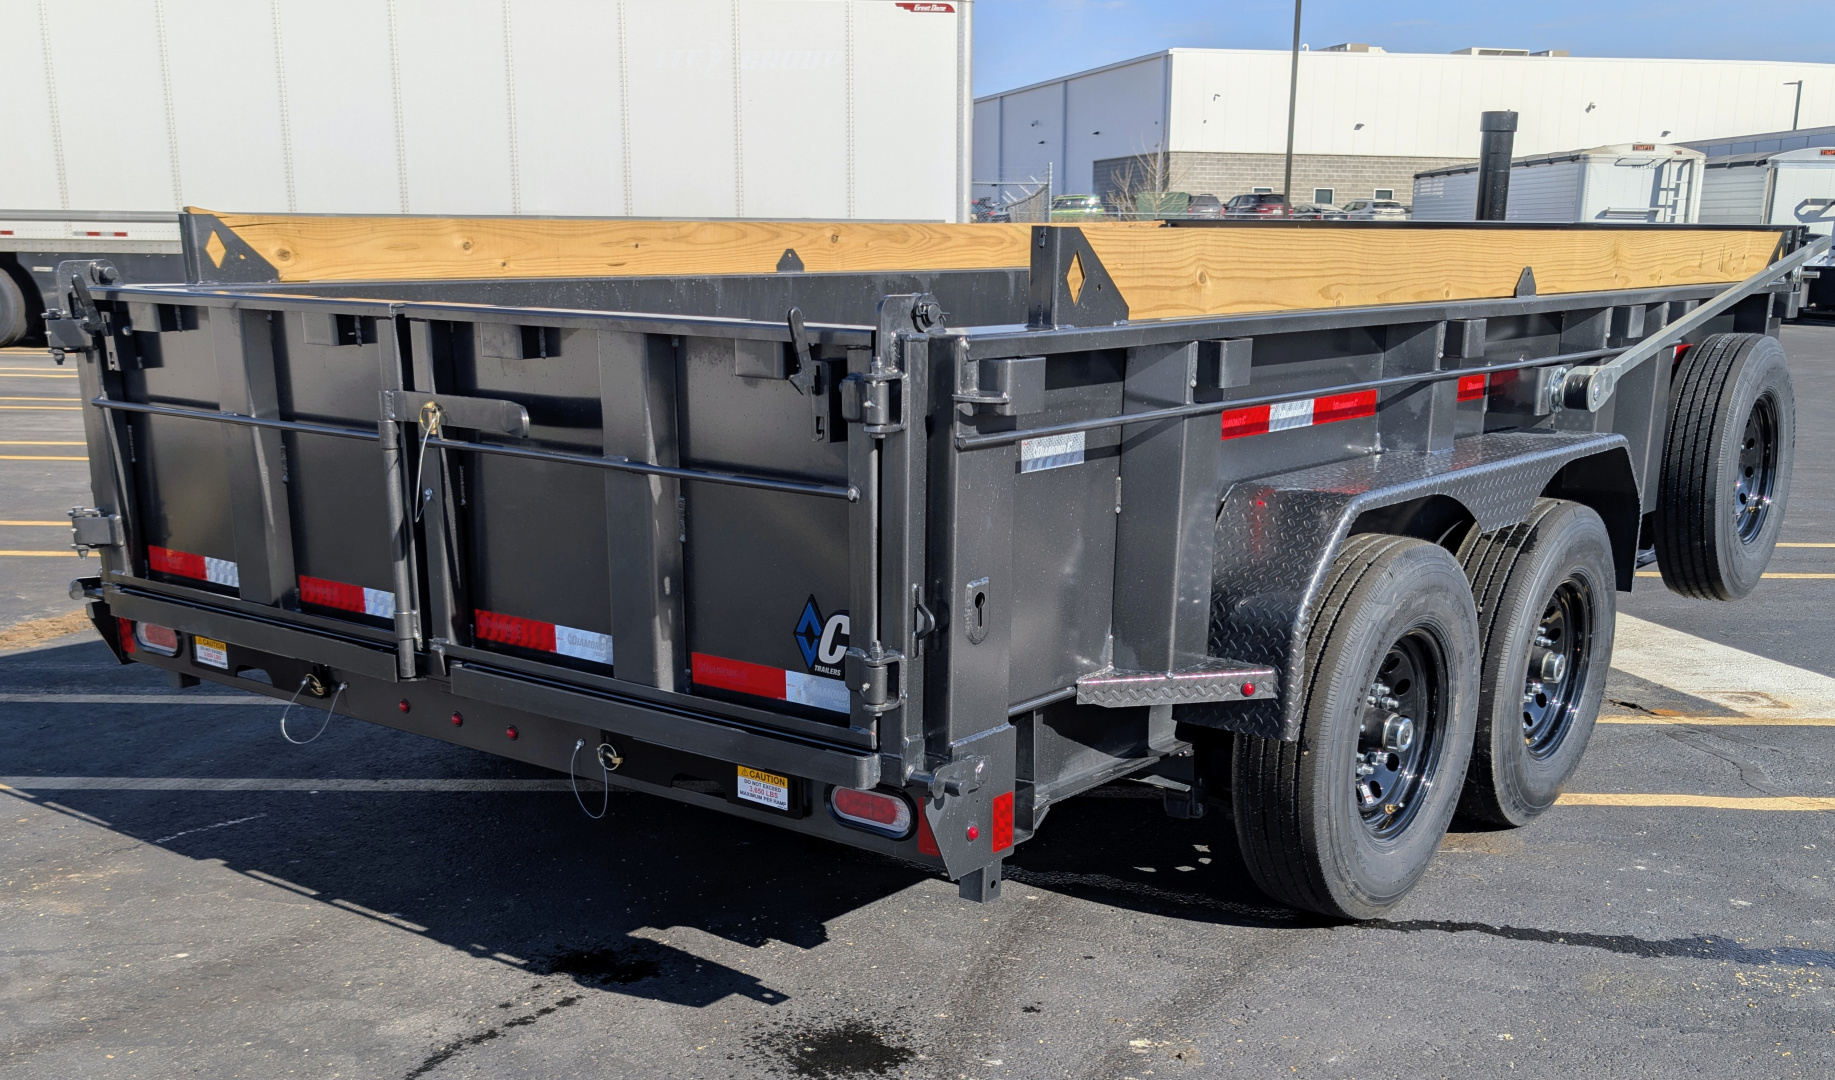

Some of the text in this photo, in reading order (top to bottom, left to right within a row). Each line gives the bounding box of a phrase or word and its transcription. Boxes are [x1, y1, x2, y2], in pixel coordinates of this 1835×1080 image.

[931, 4, 947, 12] Dane
[741, 49, 845, 70] GROUP
[202, 638, 225, 650] CAUTION
[818, 614, 850, 664] C
[814, 664, 842, 676] TRAILERS
[749, 770, 786, 786] CAUTION
[749, 785, 779, 799] 3,650 LBS
[762, 783, 782, 793] EXCEED
[739, 789, 763, 800] MAXIMUM
[773, 798, 787, 807] RAMP
